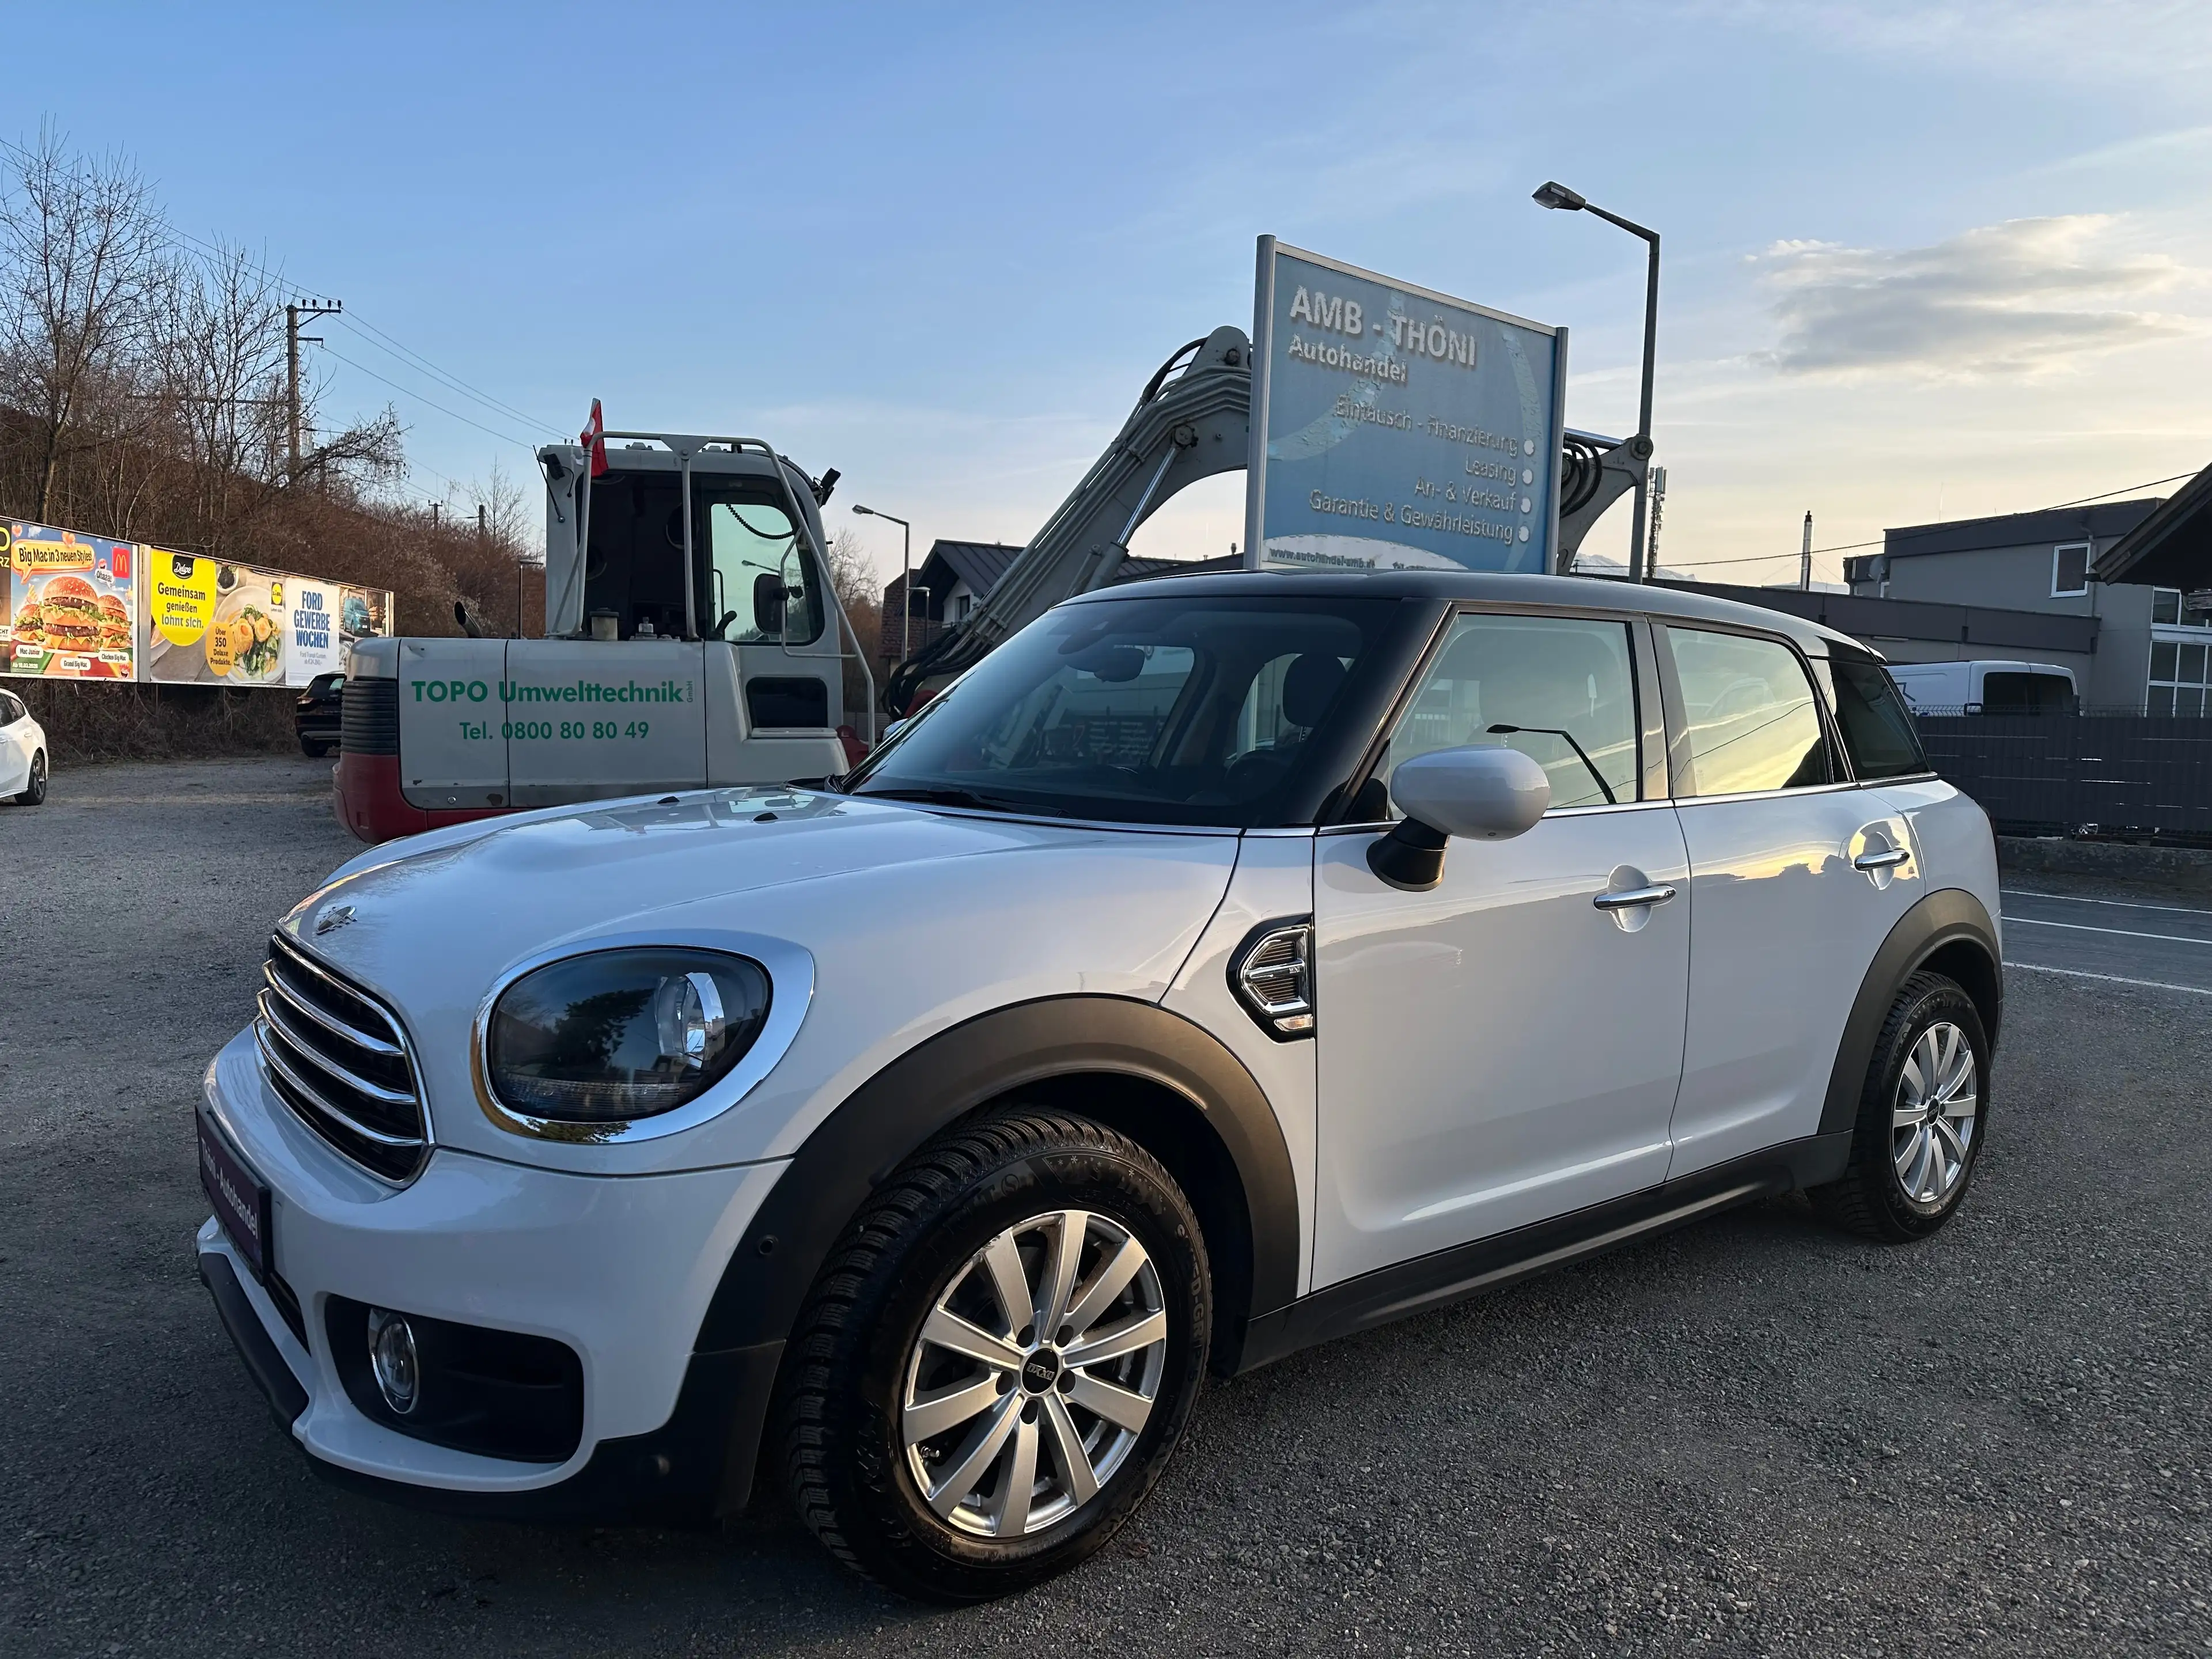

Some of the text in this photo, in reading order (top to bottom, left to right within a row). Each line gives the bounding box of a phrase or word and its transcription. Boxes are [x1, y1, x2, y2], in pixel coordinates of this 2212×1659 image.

[1290, 285, 1476, 366] AMB - THÖNI
[1288, 334, 1407, 382] Autohandel
[1336, 395, 1412, 431] Eintausch
[1427, 414, 1518, 457] Finanzierung
[1465, 454, 1517, 487] Leasing
[1415, 476, 1516, 512] An- & Verkauf
[1309, 489, 1513, 545] Garantie & Gewährleistung
[19, 547, 92, 566] Big Mac in 3 neuen Styles!
[173, 562, 191, 575] Deluxe
[158, 582, 206, 601] Gemeinsam
[302, 590, 323, 611] FORD
[166, 601, 197, 613] genießen
[161, 613, 204, 629] lohnt sich.
[294, 609, 330, 631] GEWERBE
[215, 626, 226, 635] Über
[296, 629, 328, 649] WOCHEN
[215, 637, 226, 647] 350
[210, 657, 232, 666] Produkte.
[213, 649, 228, 657] Deluxe
[411, 681, 488, 702] TOPO
[498, 680, 684, 703] Umwelttechnik
[459, 721, 650, 740] Tel. 0800 80 80 49
[219, 1167, 258, 1240] Autohandel
